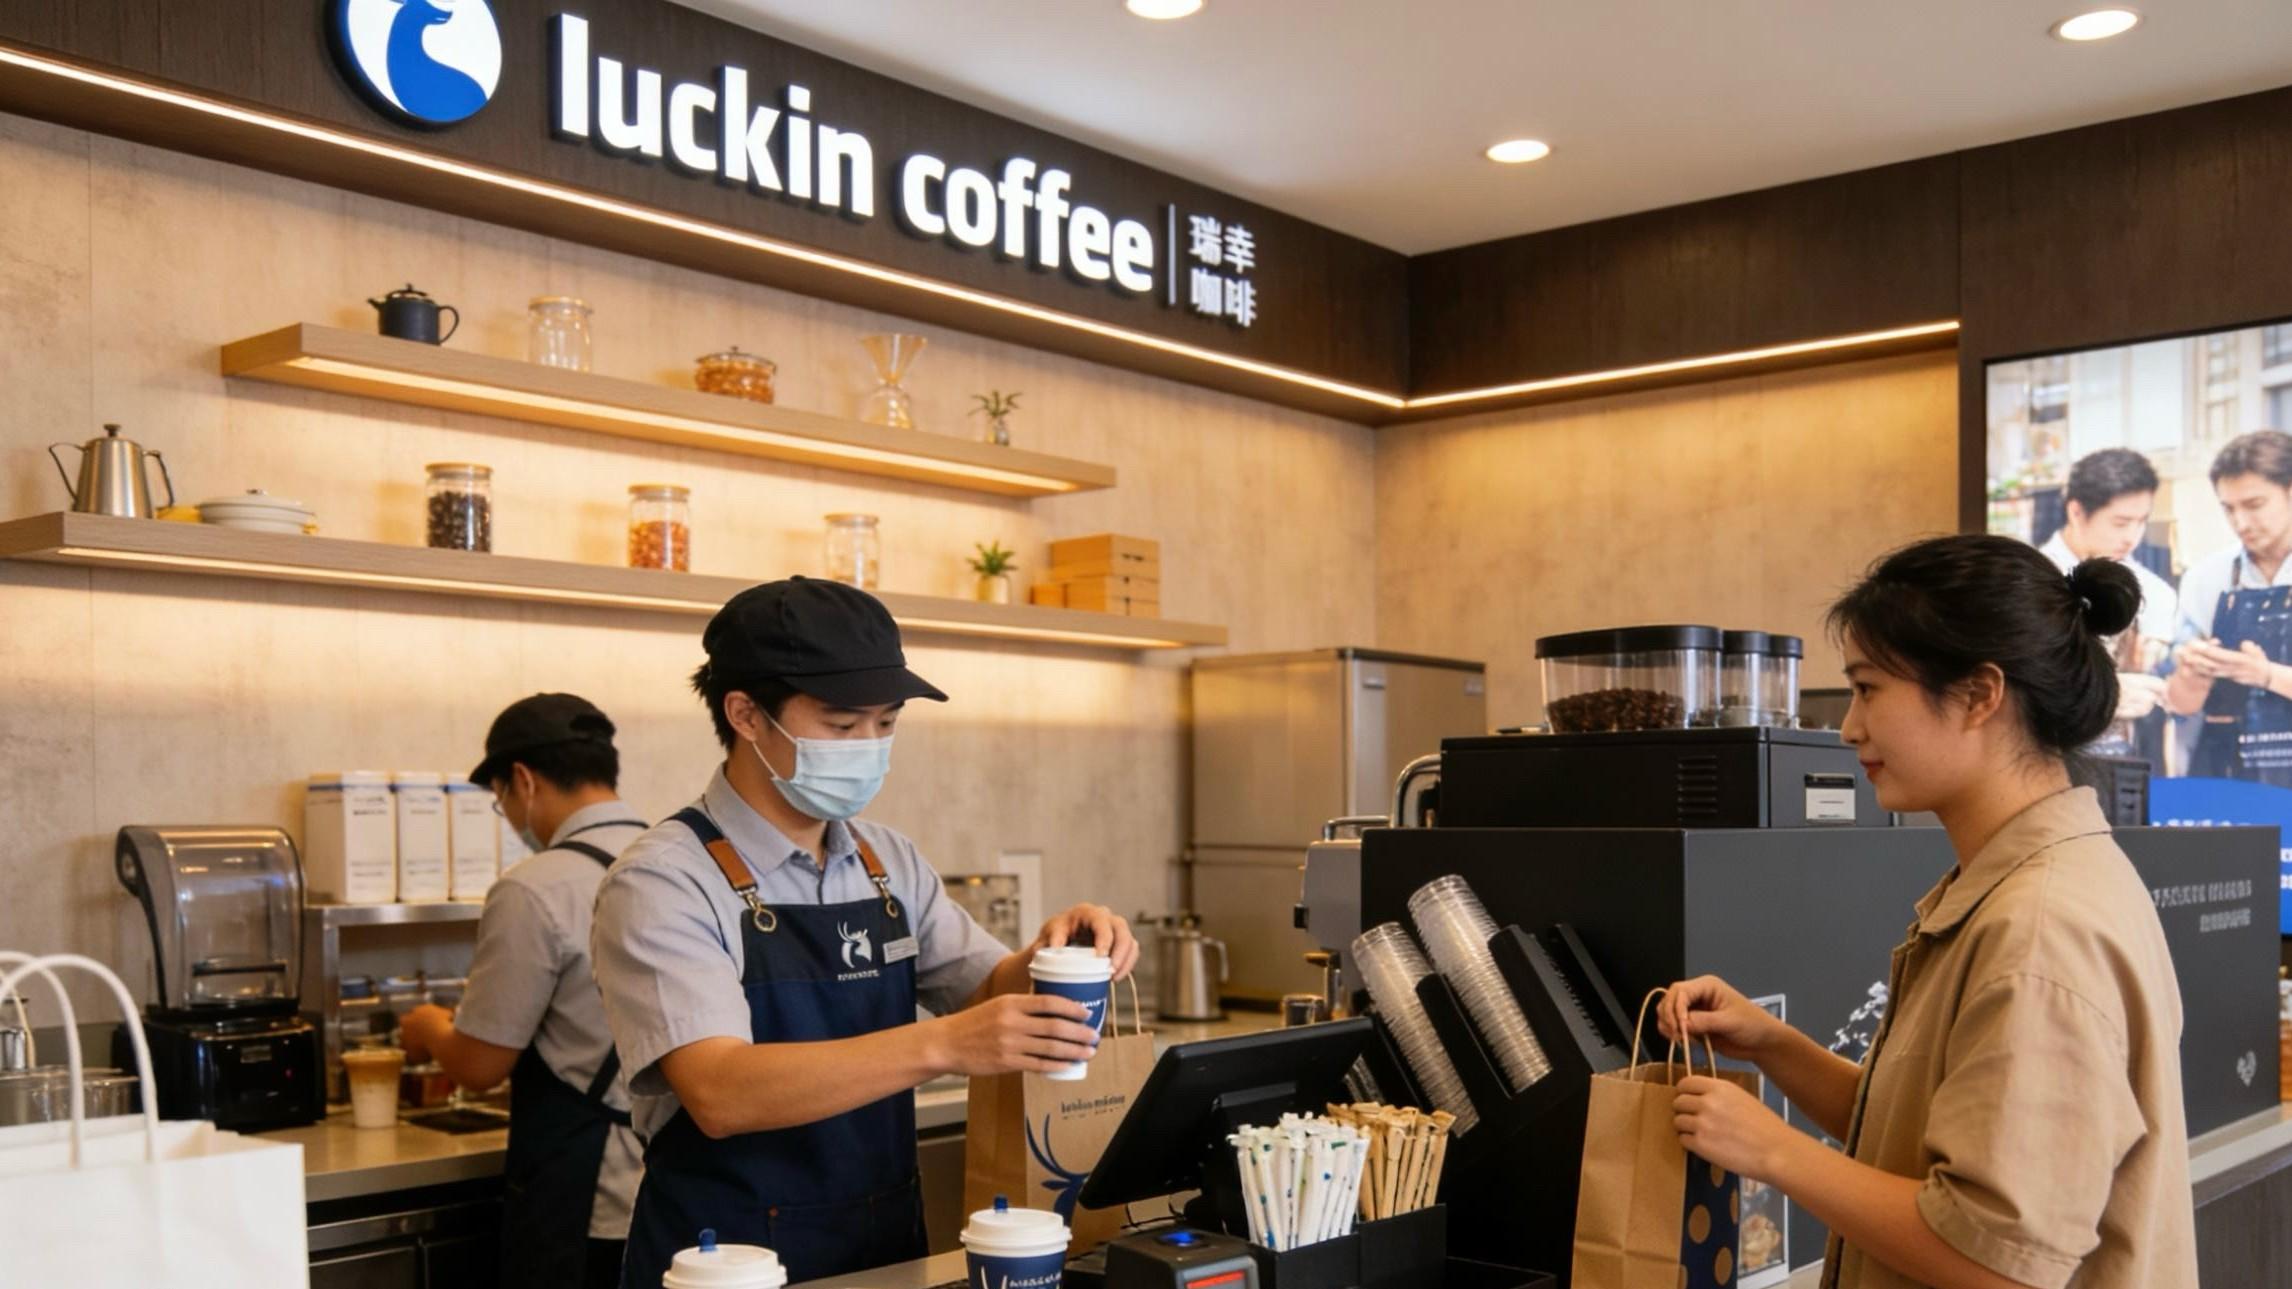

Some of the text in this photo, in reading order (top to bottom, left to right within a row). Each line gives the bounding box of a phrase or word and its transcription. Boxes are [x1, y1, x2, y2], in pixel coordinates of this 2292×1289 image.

[560, 13, 1154, 292] luckin coffee
[1188, 215, 1256, 274] 瑞幸
